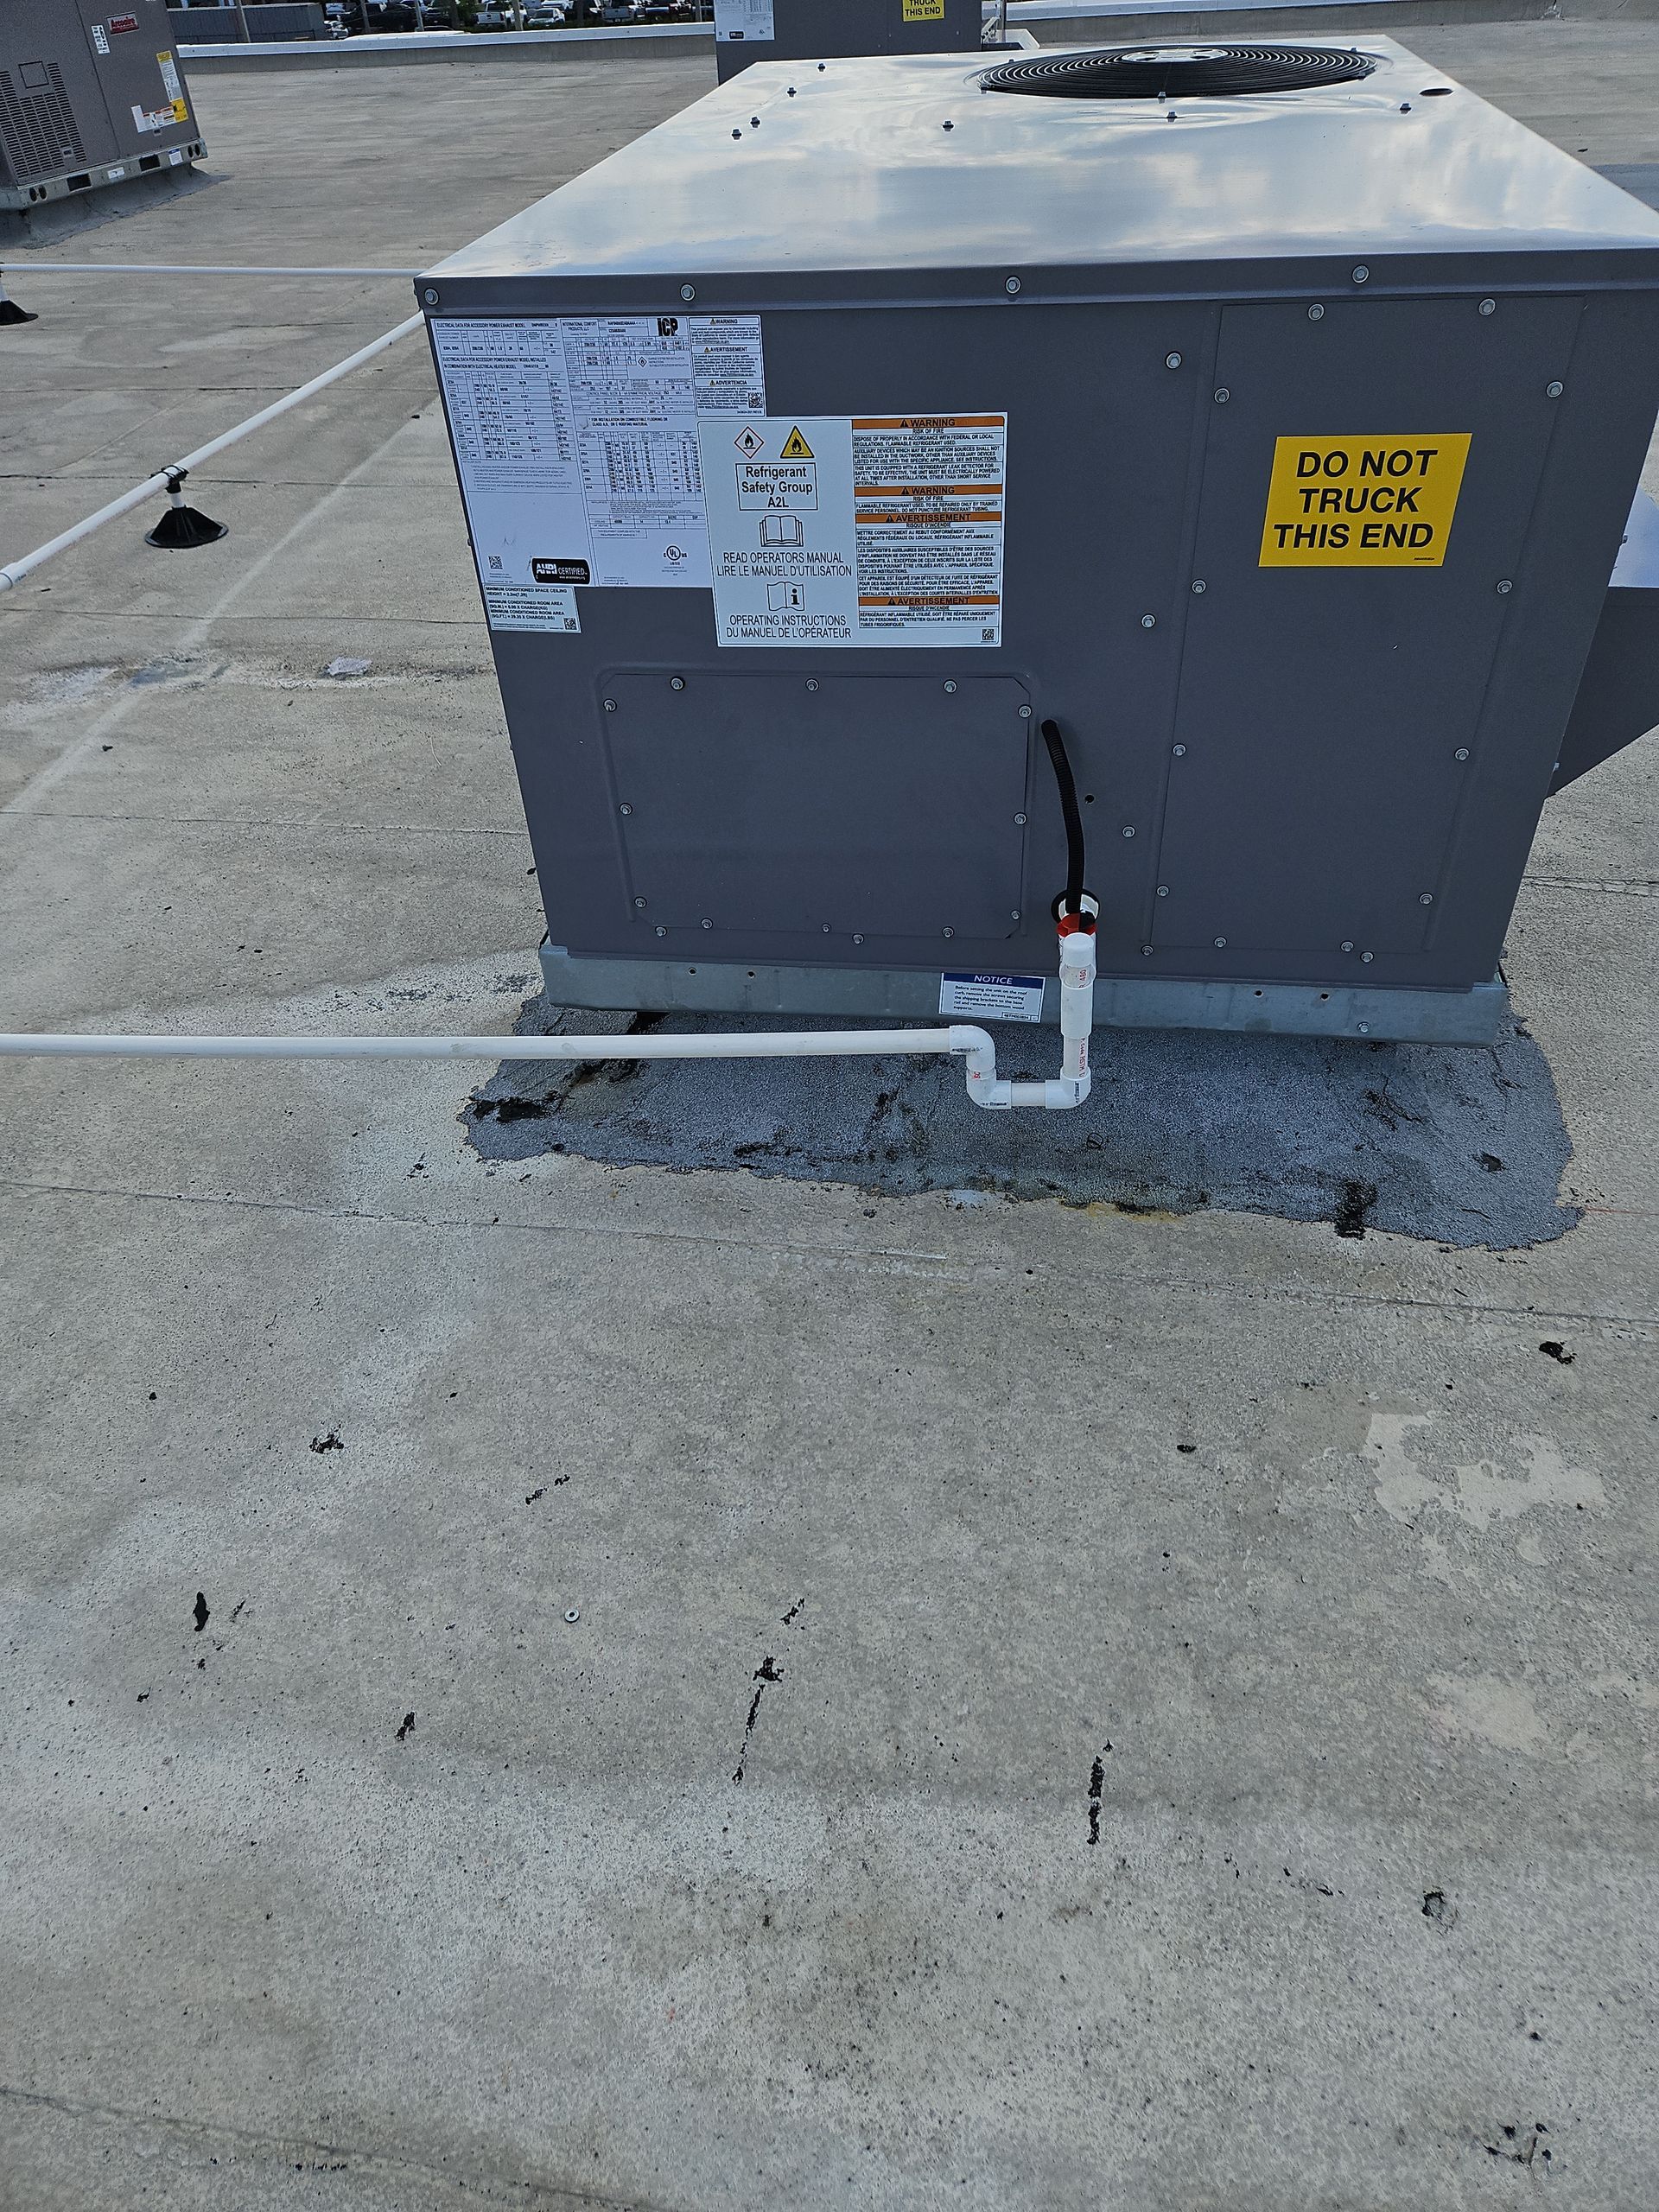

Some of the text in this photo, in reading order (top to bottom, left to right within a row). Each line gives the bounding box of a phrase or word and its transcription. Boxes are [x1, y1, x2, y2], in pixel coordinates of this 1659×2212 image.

[911, 419, 955, 427] WARNING
[1296, 450, 1438, 477] DO NOT
[745, 466, 807, 480] Refrigerant
[742, 482, 813, 495] Safety Group
[768, 497, 789, 508] A2L
[1299, 487, 1423, 513] TRUCK
[895, 514, 971, 522] AVERTISSEMENT
[1273, 523, 1433, 548] THIS END
[723, 552, 843, 563] READ OPERATORS MANUAL
[717, 566, 852, 576] LIRE LE MANUEL D'UTILISATION
[730, 615, 846, 625] OPERATING INSTRUCTIONS
[727, 625, 851, 638] DU MANUEL DE L'OPÉRATEUR
[974, 975, 1013, 985] NOTICE
